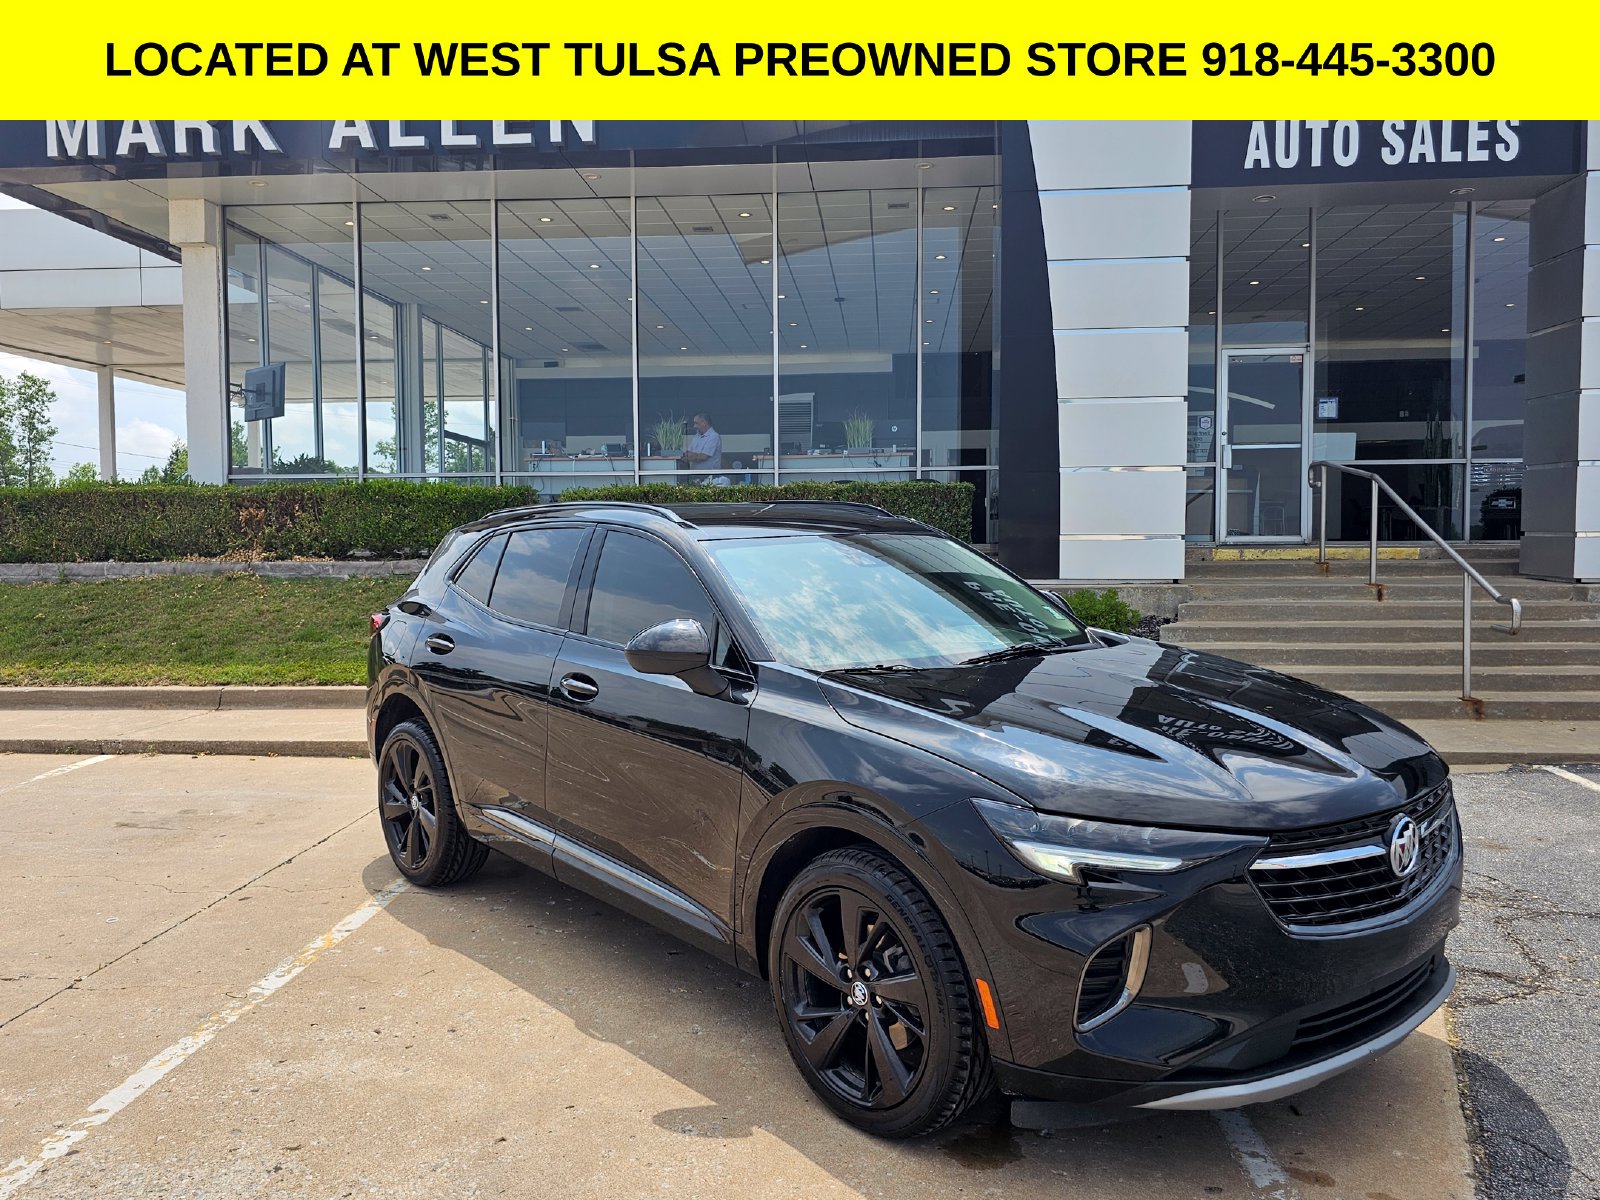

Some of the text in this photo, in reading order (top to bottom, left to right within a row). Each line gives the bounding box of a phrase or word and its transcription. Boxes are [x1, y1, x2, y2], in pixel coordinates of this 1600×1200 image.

[46, 120, 284, 158] MARK
[1243, 120, 1520, 169] AUTO SALES
[885, 893, 930, 954] GENERAL
